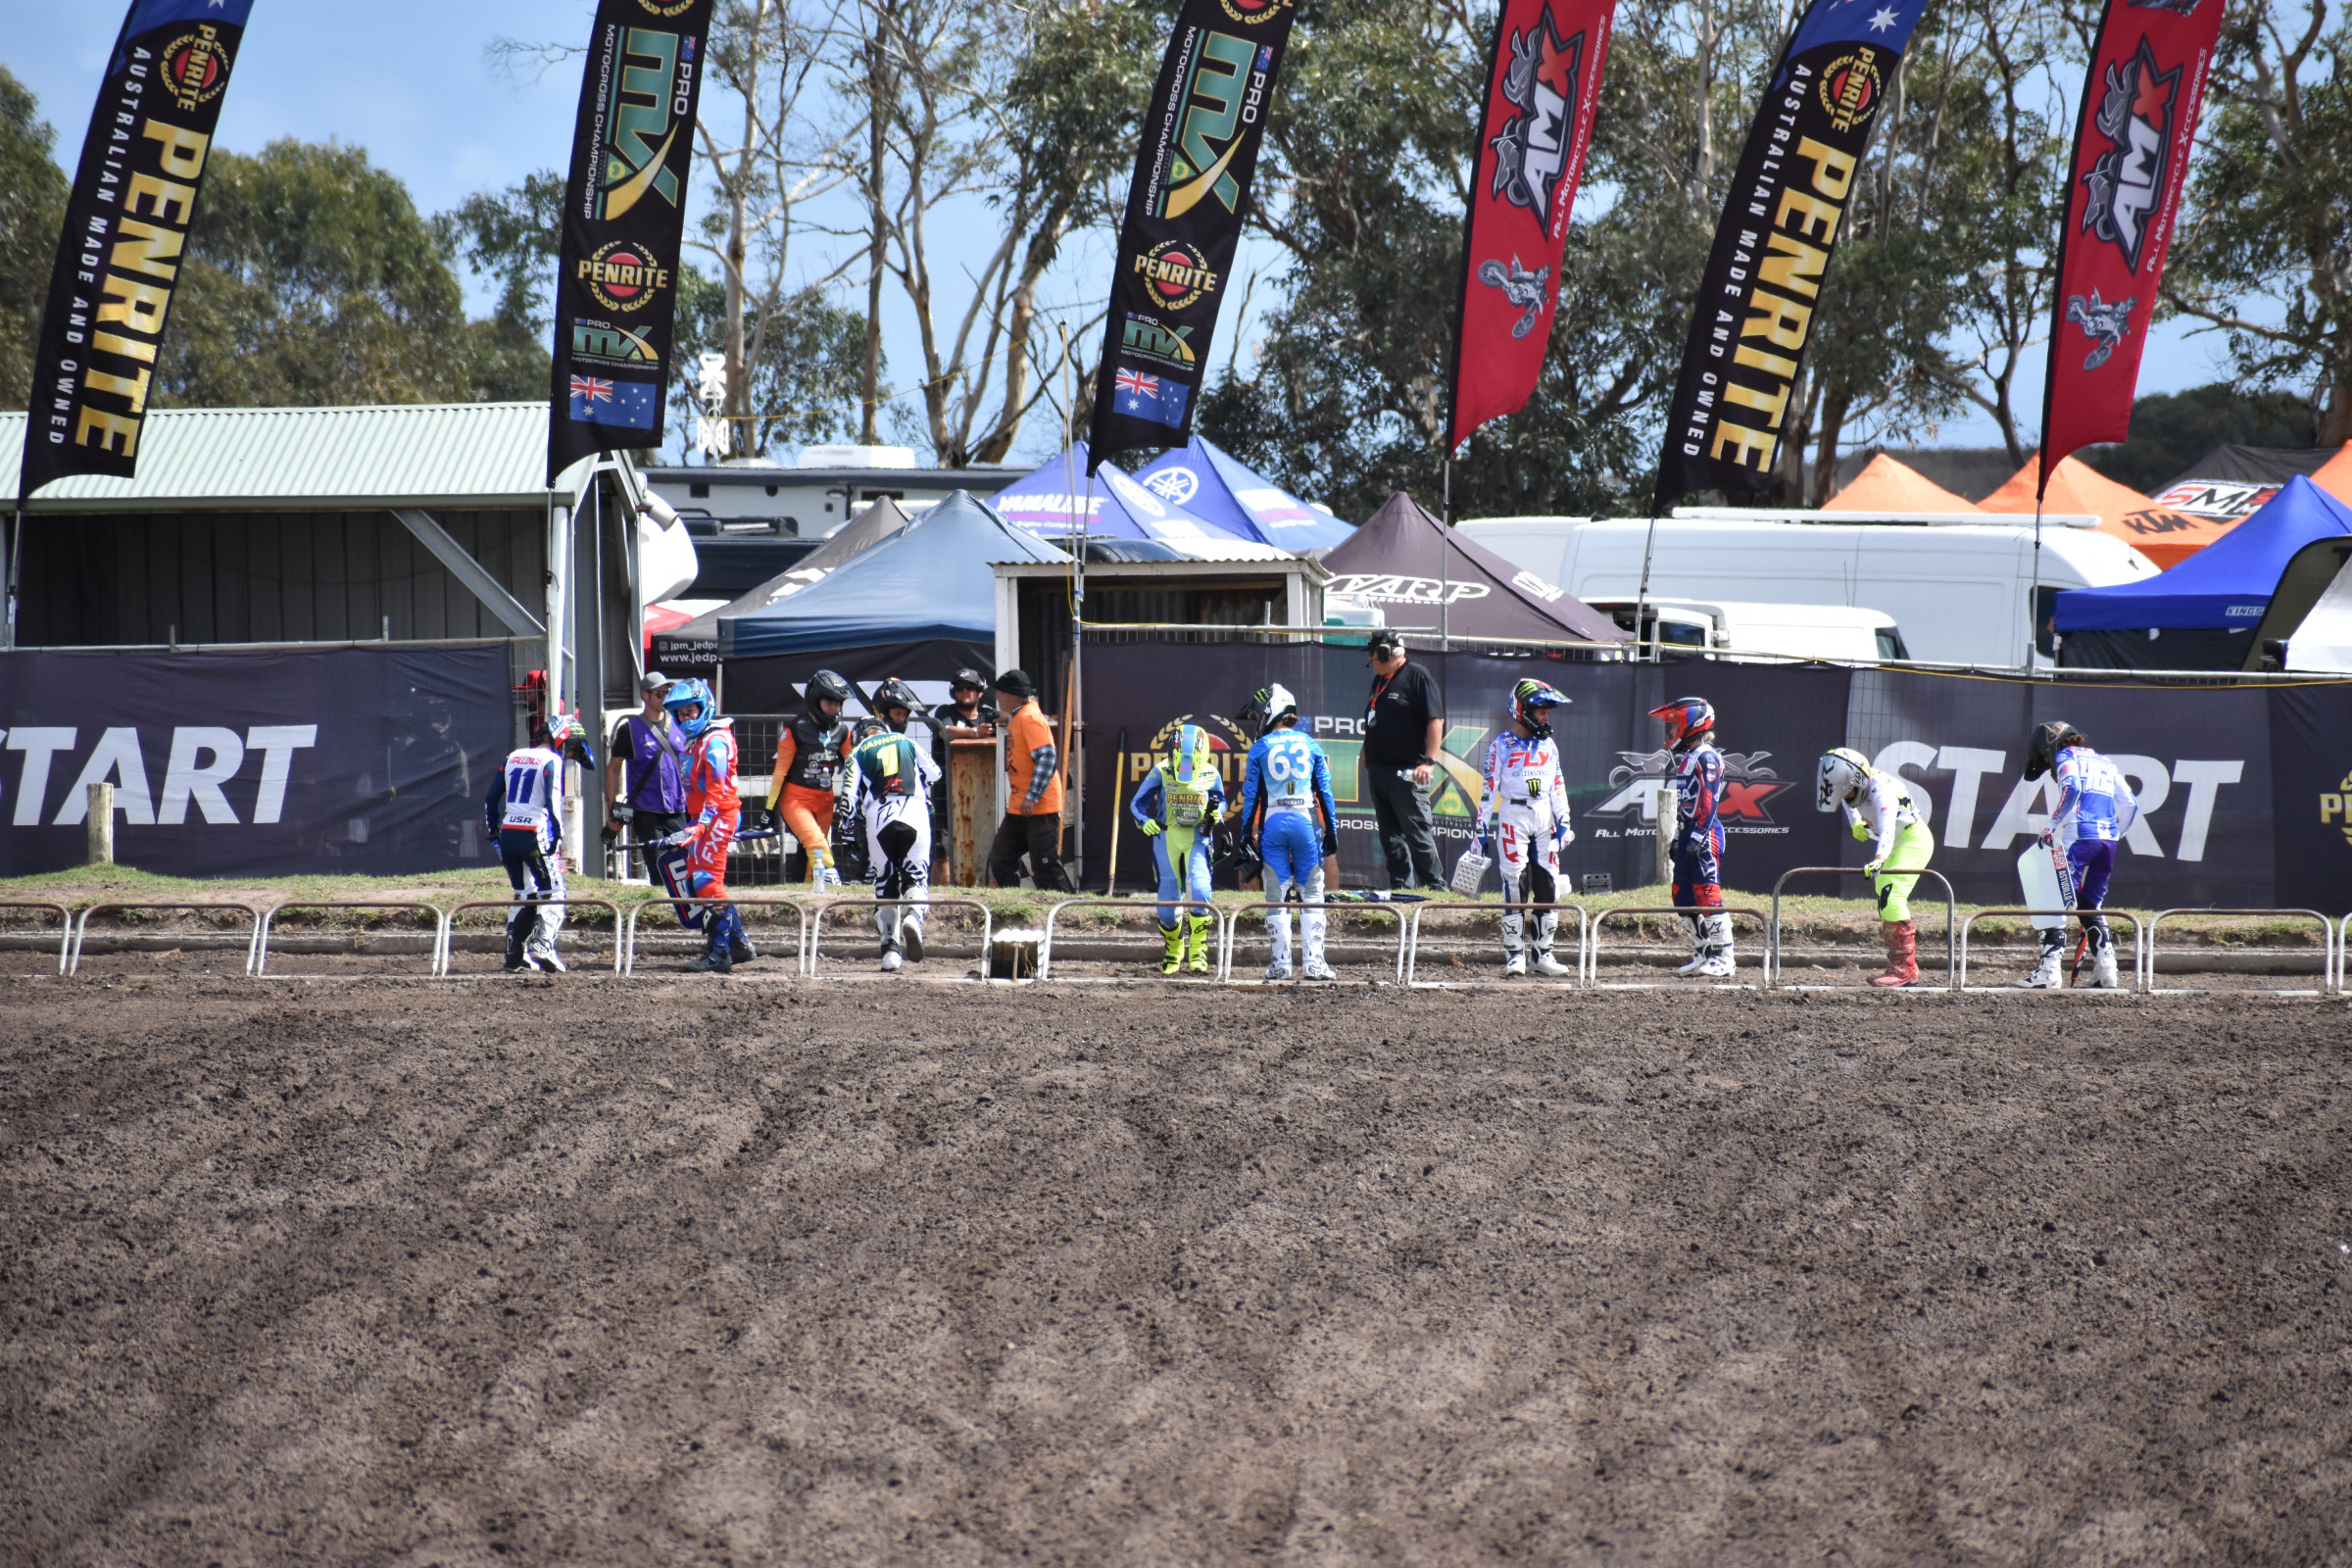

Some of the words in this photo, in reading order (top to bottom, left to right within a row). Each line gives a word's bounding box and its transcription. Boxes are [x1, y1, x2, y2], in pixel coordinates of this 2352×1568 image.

[176, 24, 217, 112] PENRITE
[595, 24, 615, 113] MOTOCROSS
[674, 62, 692, 116] PRO
[1168, 25, 1197, 112] MOTOCROSS
[1243, 71, 1266, 124] PRO
[1831, 46, 1876, 133] PENRITE
[97, 46, 151, 203] AUSTRALIAN
[1522, 15, 1579, 231] AMX
[1748, 63, 1812, 219] AUSTRALIAN
[2112, 46, 2180, 265] AMX
[584, 114, 605, 220] CHAMPIONSHIP
[1146, 112, 1174, 217] CHAMPIONSHIP
[1553, 210, 1565, 239] ALL
[1559, 113, 1591, 207] MOTORCYCLE
[2146, 244, 2160, 272] ALL
[2156, 149, 2185, 242] MOTORCYCLE
[78, 216, 107, 283] MADE
[578, 260, 668, 288] PENRITE
[1134, 255, 1217, 292] PENRITE
[1724, 228, 1758, 298] MADE
[66, 295, 89, 344] AND
[75, 118, 210, 458] PENRITE
[1138, 315, 1158, 325] PRO
[1709, 134, 1857, 473] PENRITE
[587, 319, 611, 329] PRO
[1709, 309, 1734, 359] AND
[49, 360, 77, 445] OWNED
[1684, 371, 1717, 457] OWNED
[2122, 510, 2199, 535] KTM
[0, 724, 318, 825] TART
[507, 767, 538, 805] 11
[877, 743, 900, 778] 1
[1267, 743, 1310, 781] 63
[1507, 751, 1549, 768] FLY
[509, 815, 533, 824] USA
[1592, 776, 1788, 821] AX
[1866, 740, 2245, 861] START
[701, 817, 730, 864] FXR
[1501, 822, 1521, 864] FLY
[1594, 828, 1621, 838] ALL
